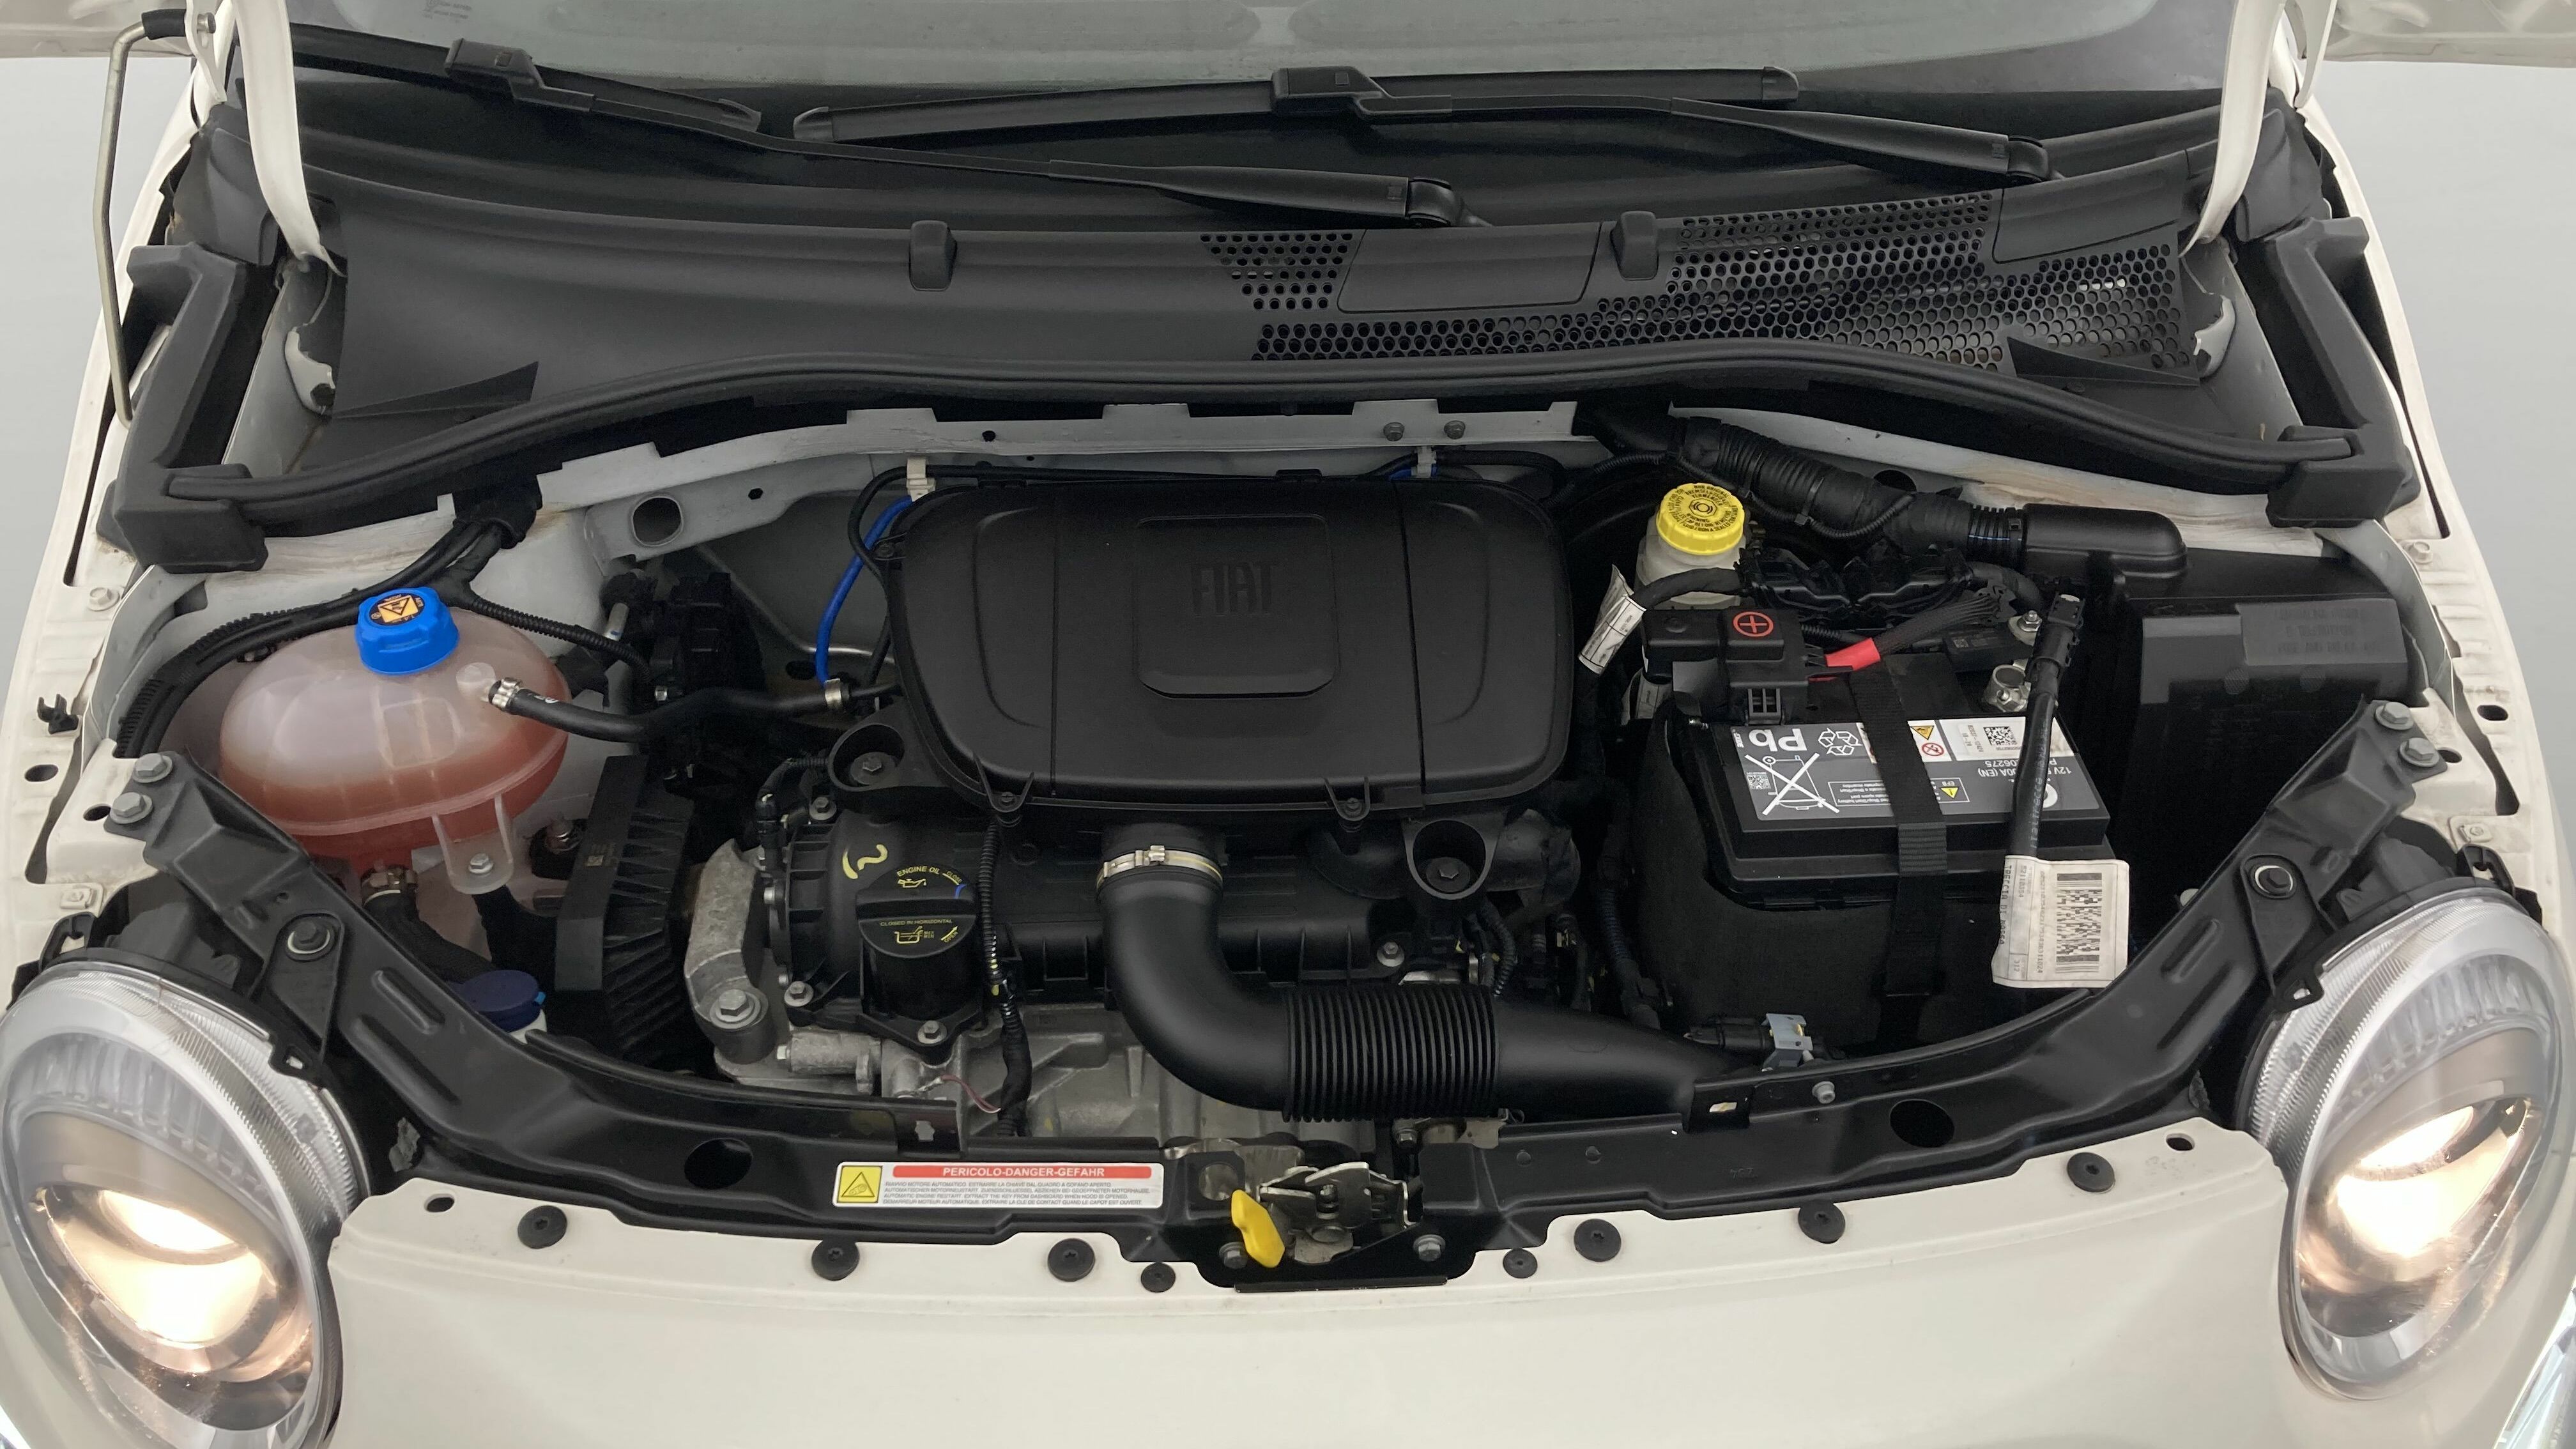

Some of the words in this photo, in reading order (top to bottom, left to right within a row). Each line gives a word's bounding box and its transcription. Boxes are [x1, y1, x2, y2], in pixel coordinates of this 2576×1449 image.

[1191, 562, 1275, 615] FIAT
[1748, 728, 1808, 753] Pb
[1985, 758, 2020, 767] 06275
[1977, 767, 1998, 778] (EN)
[2054, 766, 2072, 775] 12V
[896, 866, 928, 877] ENGINE
[928, 866, 940, 875] OIL
[942, 1167, 1105, 1177] PERICOLO-DANGER-GEFAHR
